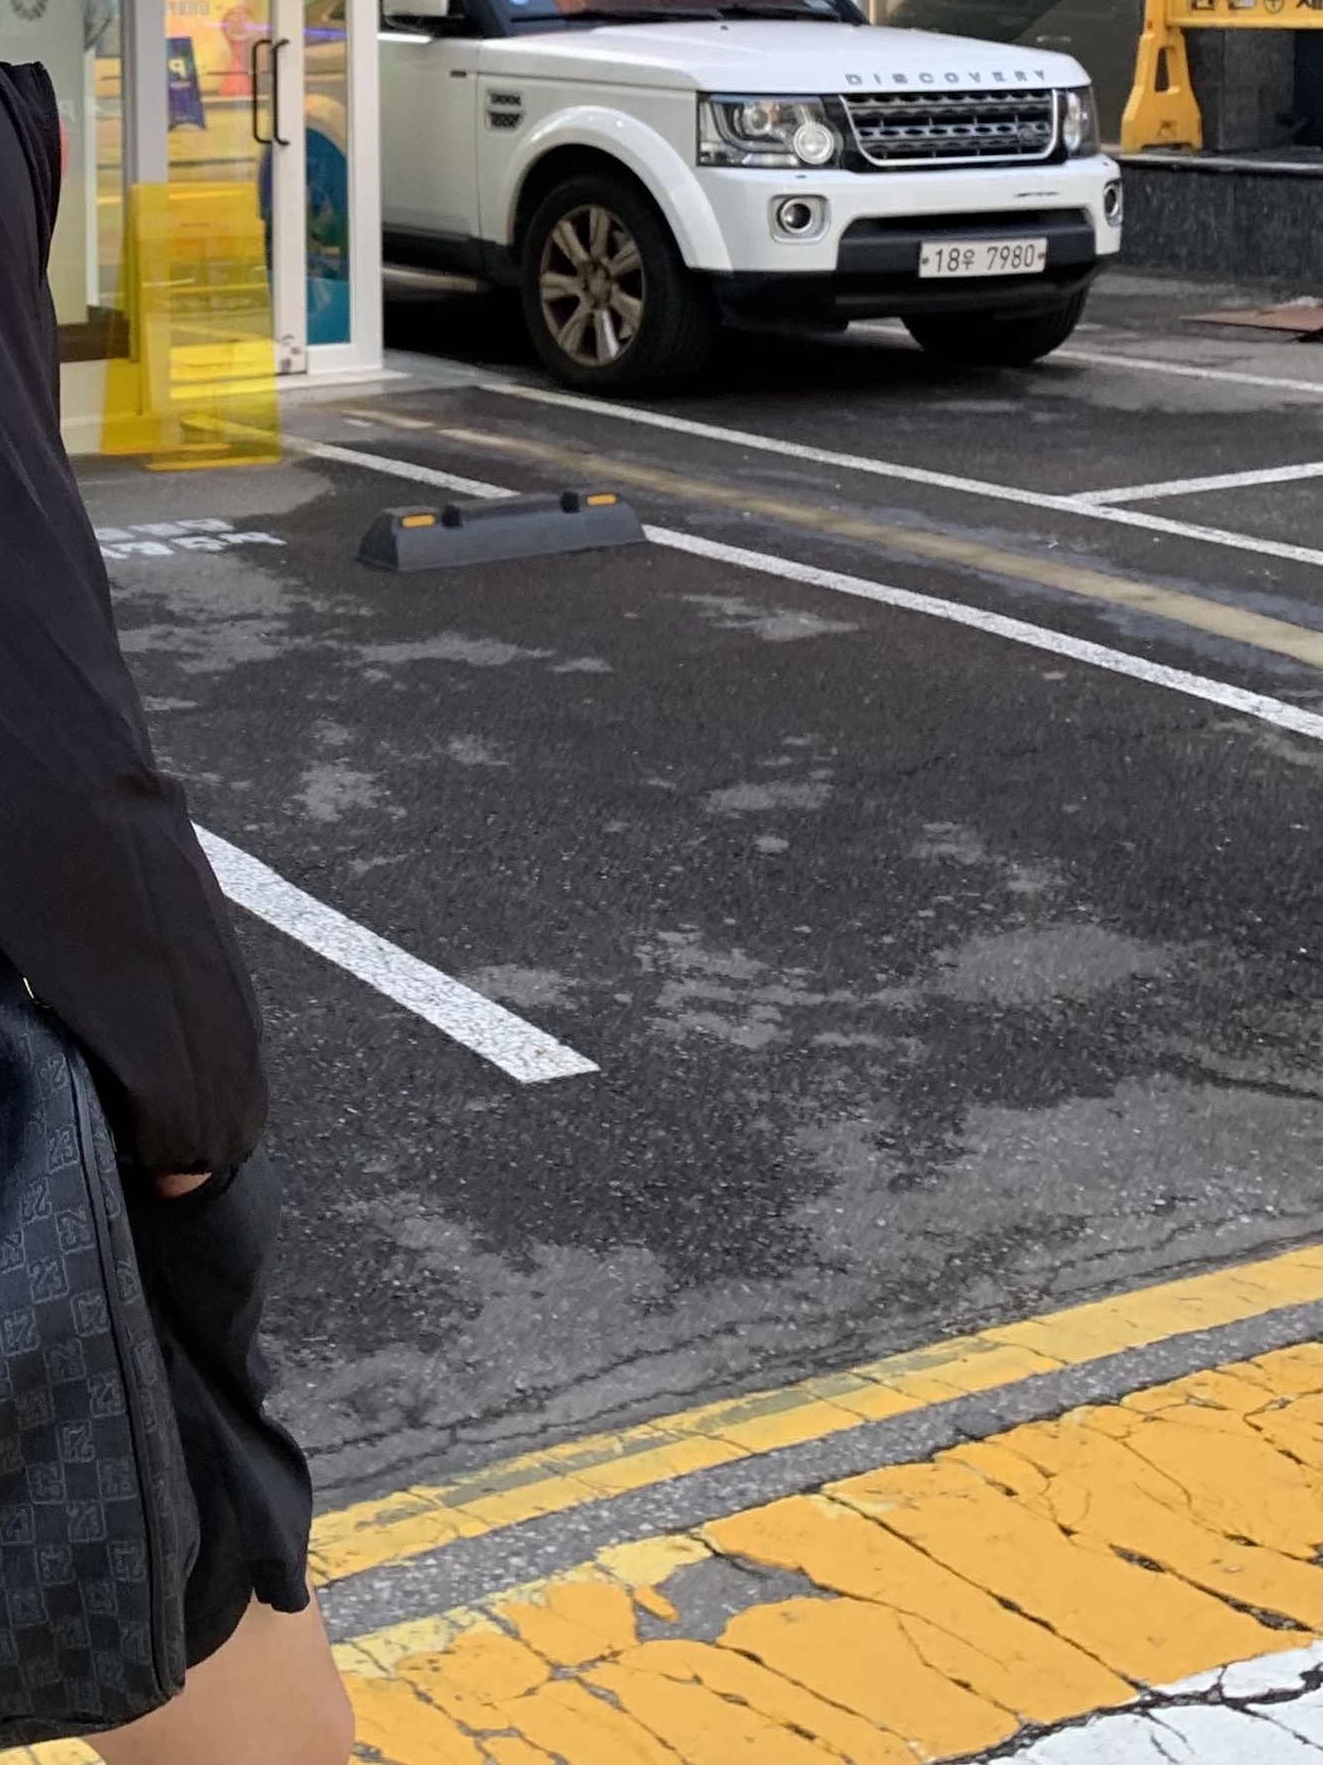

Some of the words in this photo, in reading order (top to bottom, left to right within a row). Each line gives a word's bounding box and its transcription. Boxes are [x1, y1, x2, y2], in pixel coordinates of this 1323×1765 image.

[845, 69, 1046, 87] DISCOVERY
[934, 246, 975, 273] 18우
[987, 244, 1035, 271] 7980
